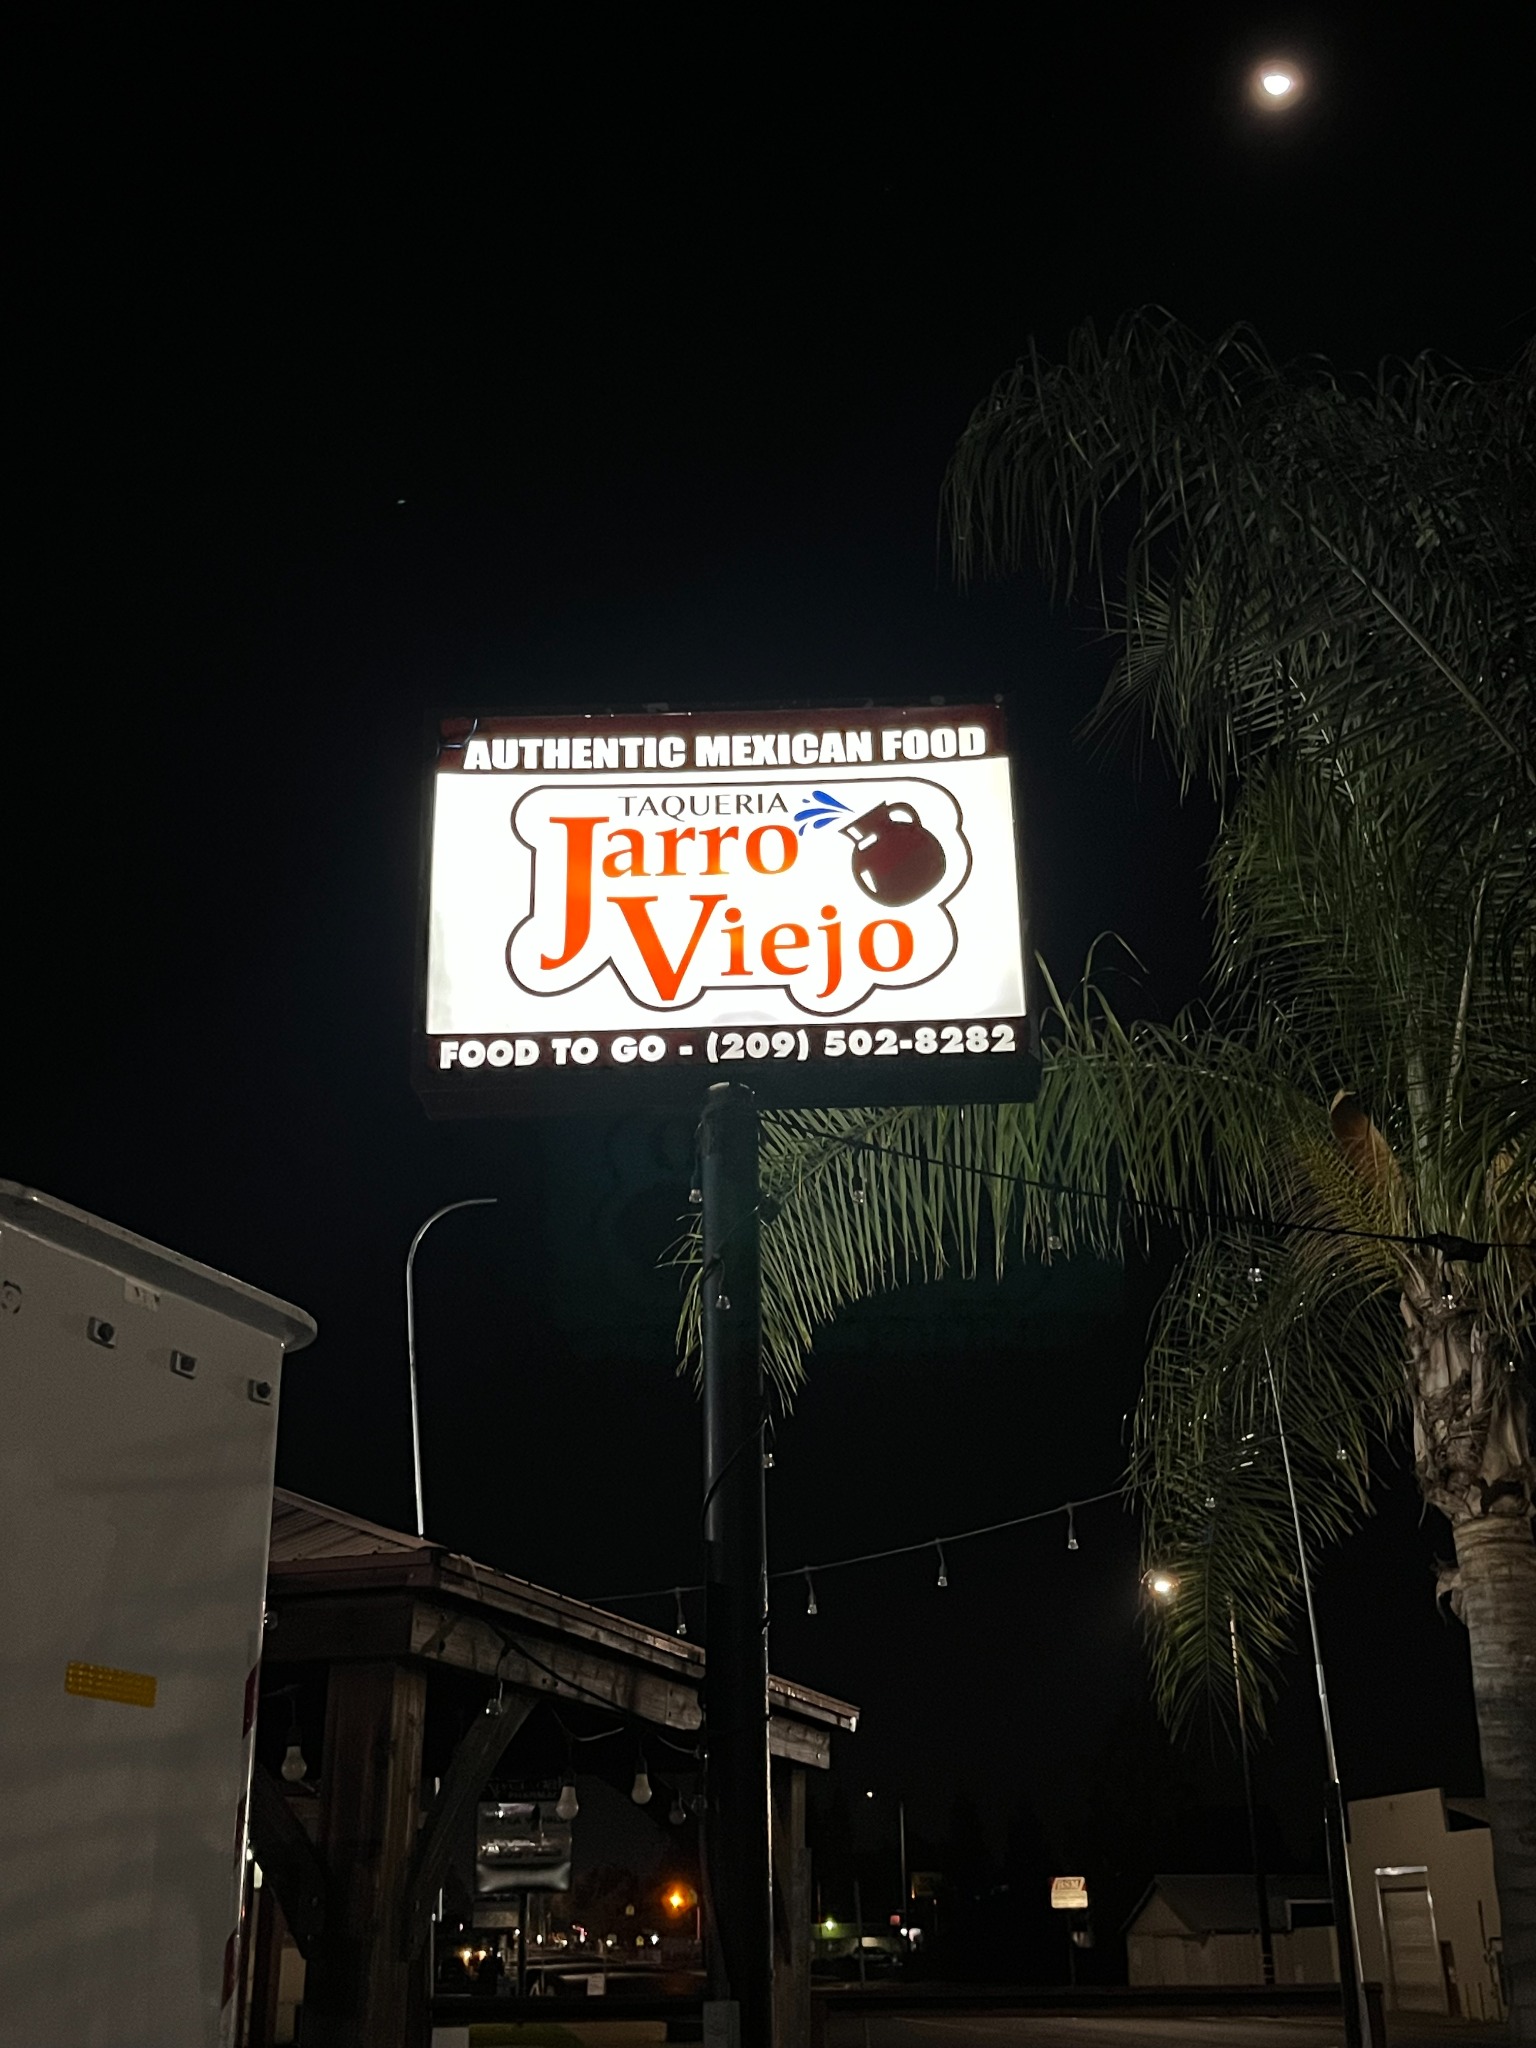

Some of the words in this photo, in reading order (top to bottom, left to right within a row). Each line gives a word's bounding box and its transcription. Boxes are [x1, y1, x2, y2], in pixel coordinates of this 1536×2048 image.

[464, 734, 686, 770] AUTHENTIC
[696, 731, 872, 768] MEXICAN
[882, 726, 986, 760] FOOD
[618, 792, 788, 822] TAQUERIA
[540, 816, 799, 970] Jarro
[608, 893, 914, 1001] Viejo
[440, 1038, 539, 1068] FOOD
[552, 1038, 599, 1066] TO
[612, 1036, 665, 1063] GO
[707, 1030, 808, 1063] (209)
[824, 1025, 1015, 1057] 502-8282
